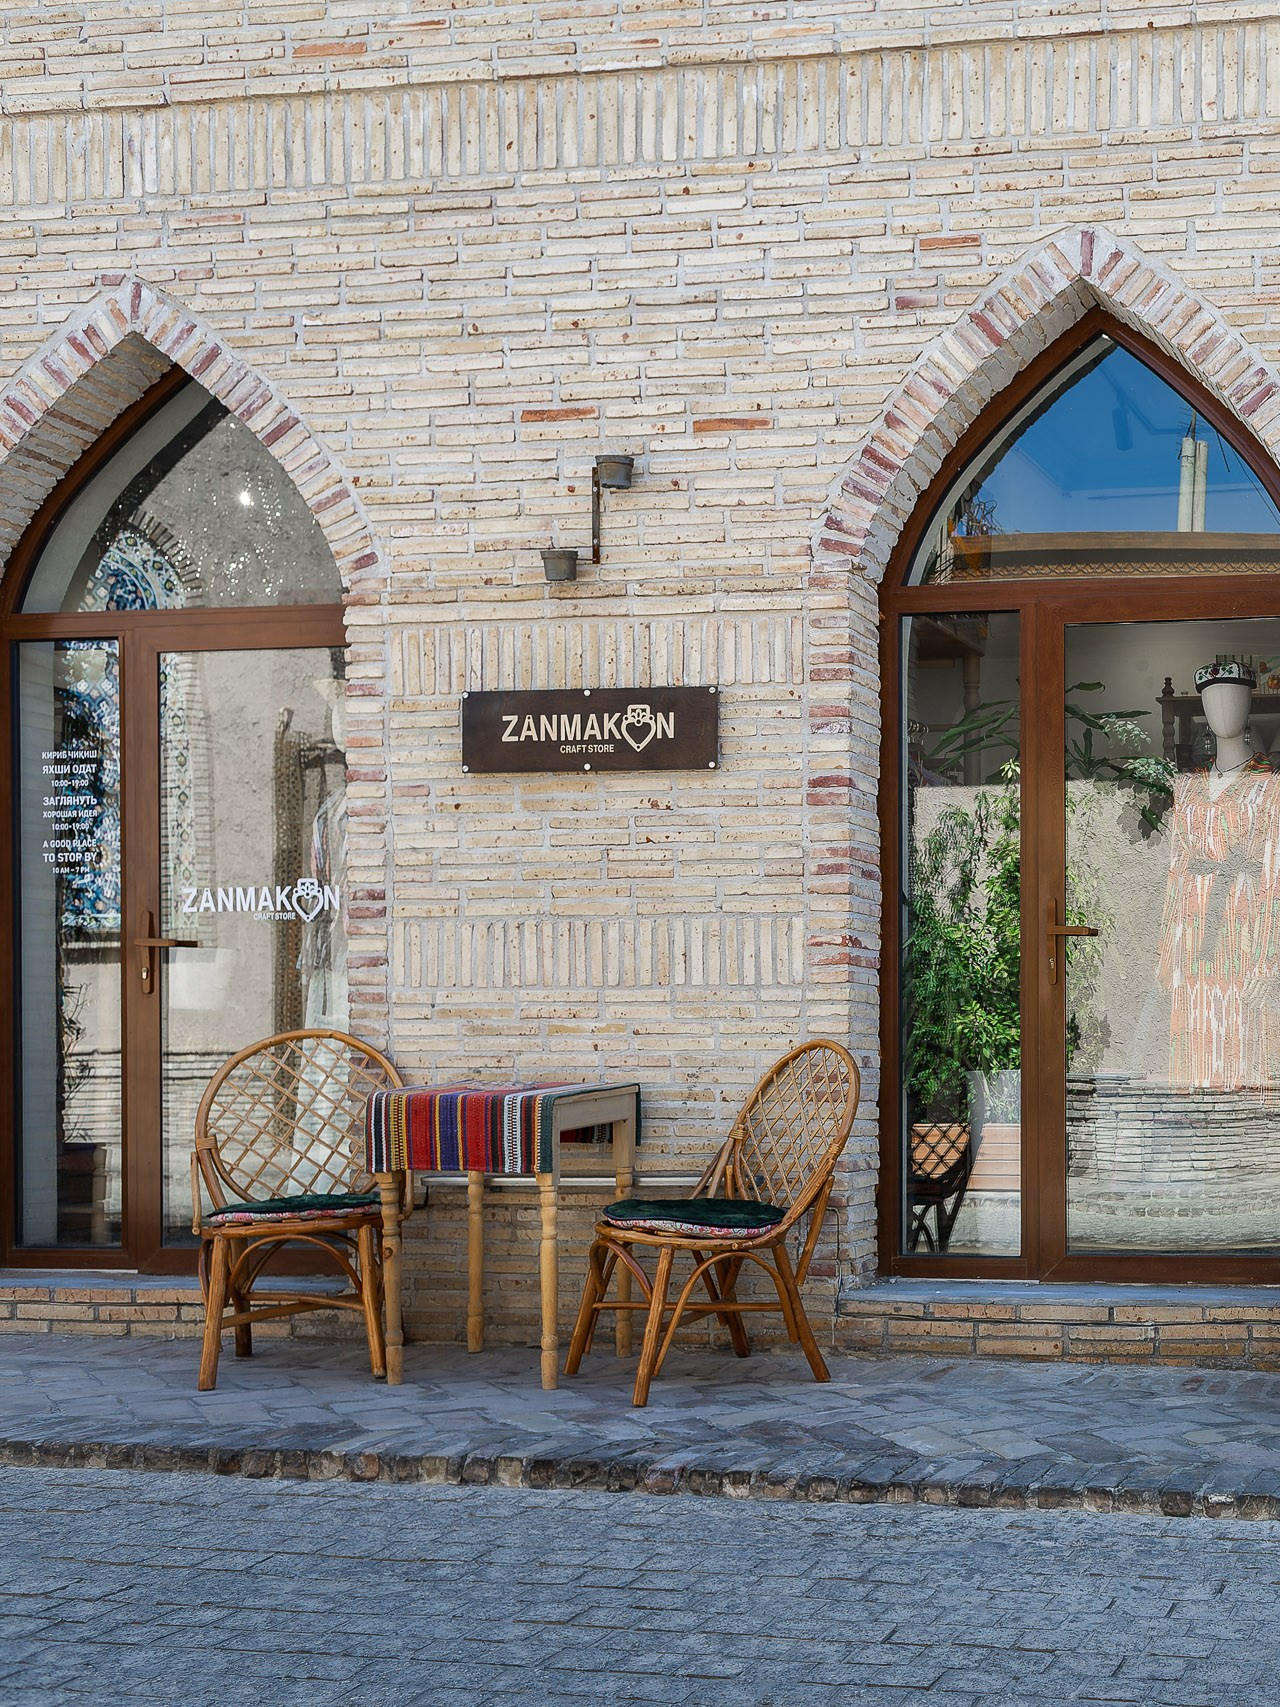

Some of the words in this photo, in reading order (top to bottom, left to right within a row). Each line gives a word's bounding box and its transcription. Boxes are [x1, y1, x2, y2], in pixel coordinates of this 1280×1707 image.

[560, 744, 587, 754] CRAFT
[588, 744, 615, 753] STORE
[42, 751, 67, 760] КИРИБ
[42, 765, 71, 775] ЯХШИ
[72, 764, 97, 775] ОДАТ
[43, 795, 97, 806] ЗАГЛЯНУТЬ
[42, 810, 77, 818] ХОРОШАЯ
[78, 810, 97, 818] ИДЕЯ
[42, 840, 49, 848] A
[50, 840, 71, 848] GOOD
[72, 839, 97, 847] PLACE
[42, 853, 55, 863] TO
[57, 852, 82, 863] STOP
[84, 852, 97, 862] BY
[254, 913, 274, 921] CRAFT
[275, 912, 296, 920] STORE
